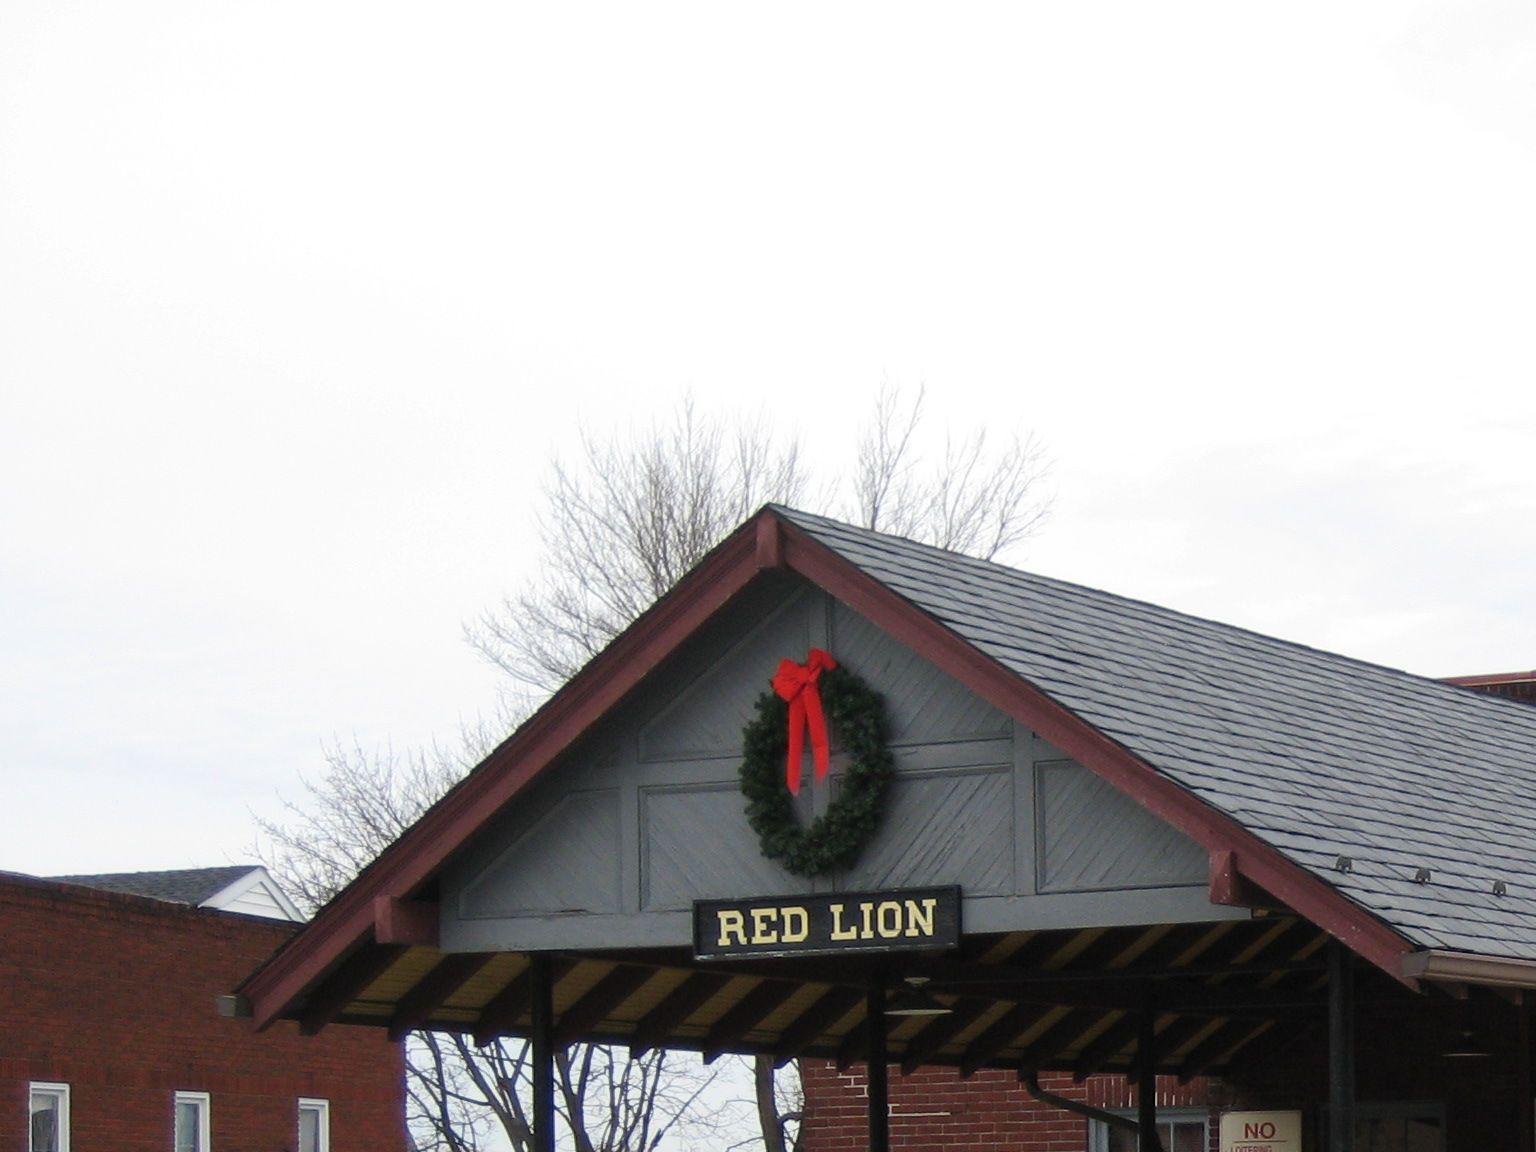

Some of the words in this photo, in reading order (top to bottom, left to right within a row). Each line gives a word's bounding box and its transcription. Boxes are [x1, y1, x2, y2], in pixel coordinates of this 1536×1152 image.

[717, 907, 809, 946] RED
[830, 899, 936, 941] LION
[1244, 1122, 1276, 1139] NO
